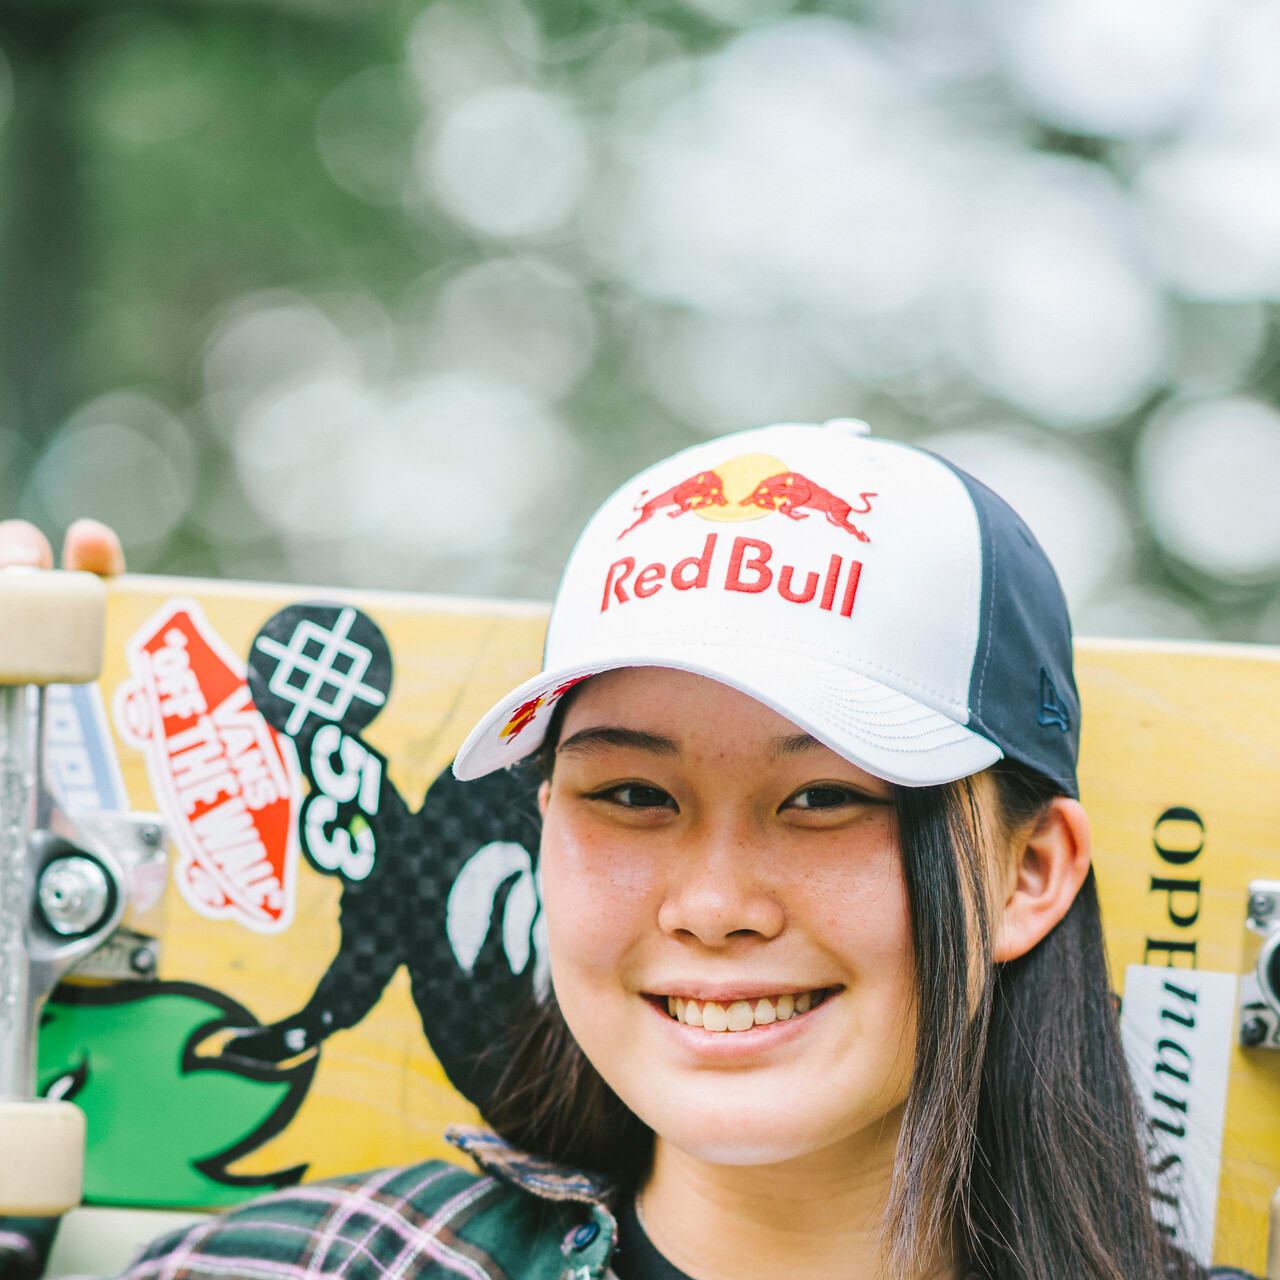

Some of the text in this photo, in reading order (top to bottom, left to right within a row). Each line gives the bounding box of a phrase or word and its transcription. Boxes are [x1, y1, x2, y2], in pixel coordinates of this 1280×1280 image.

[599, 532, 863, 619] Red Bull
[167, 714, 239, 815] THE
[214, 685, 292, 811] VANS
[306, 726, 384, 881] 53
